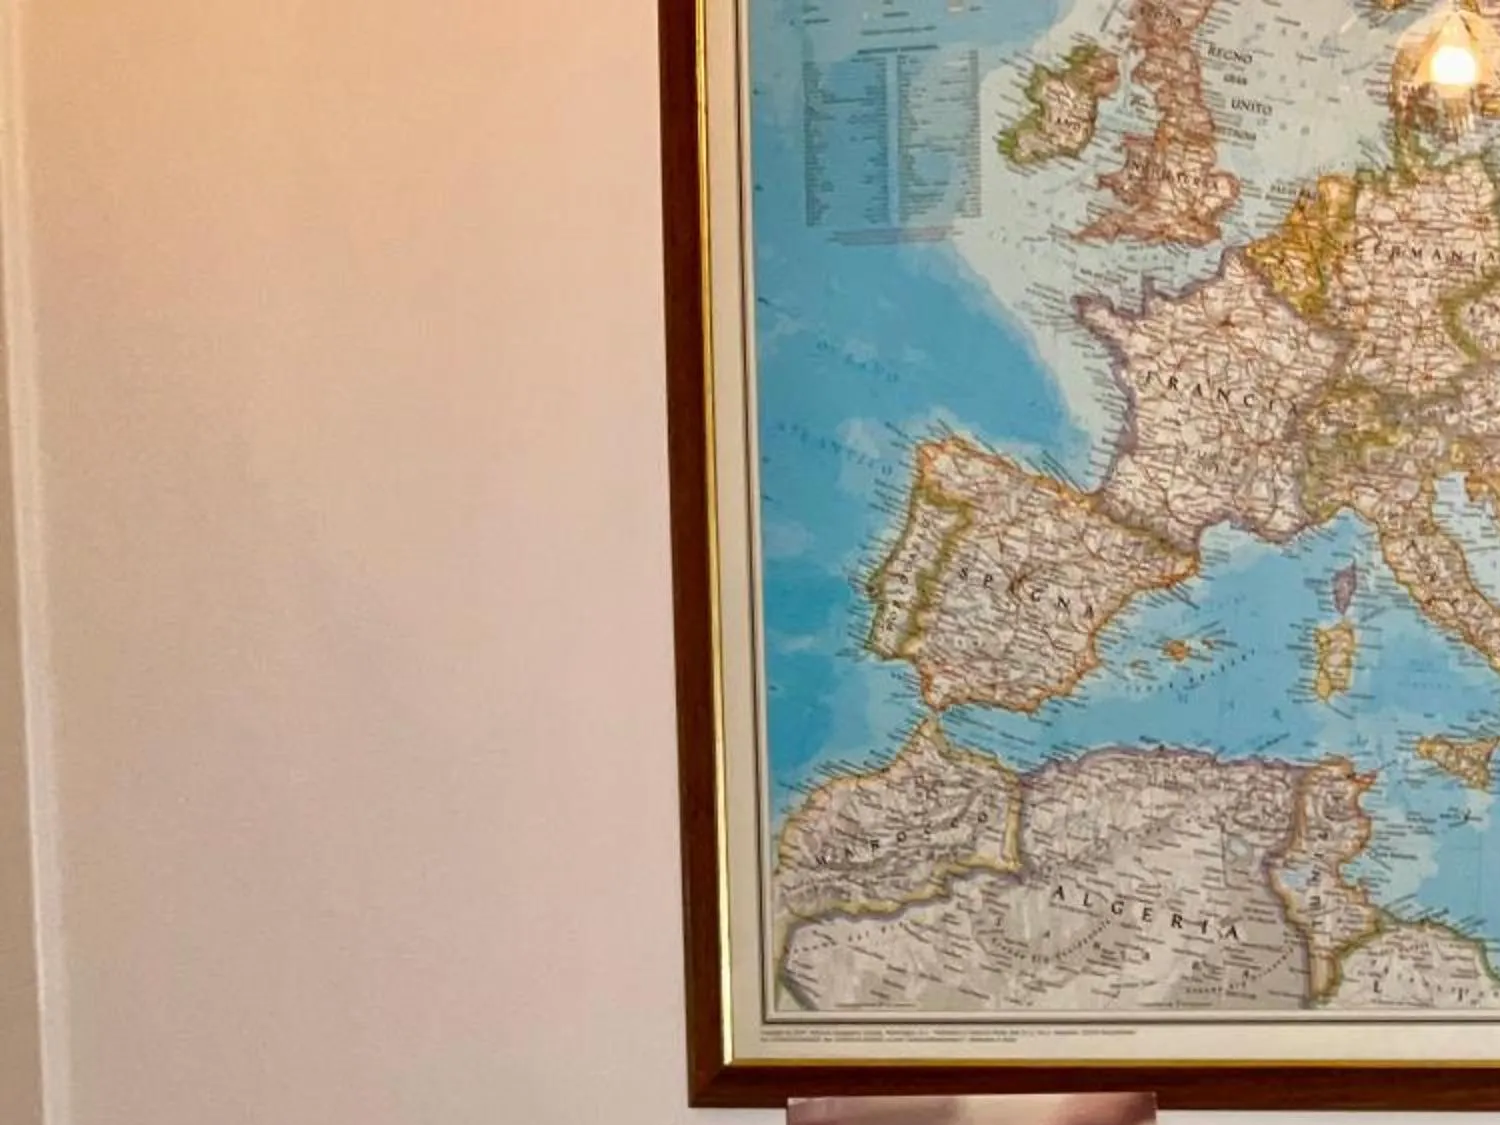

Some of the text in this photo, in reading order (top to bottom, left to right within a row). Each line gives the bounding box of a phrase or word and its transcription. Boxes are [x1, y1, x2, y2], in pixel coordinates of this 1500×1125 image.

[1207, 44, 1253, 65] REGNO
[1230, 98, 1274, 116] UNITO
[1052, 885, 1239, 942] ALGERIA
